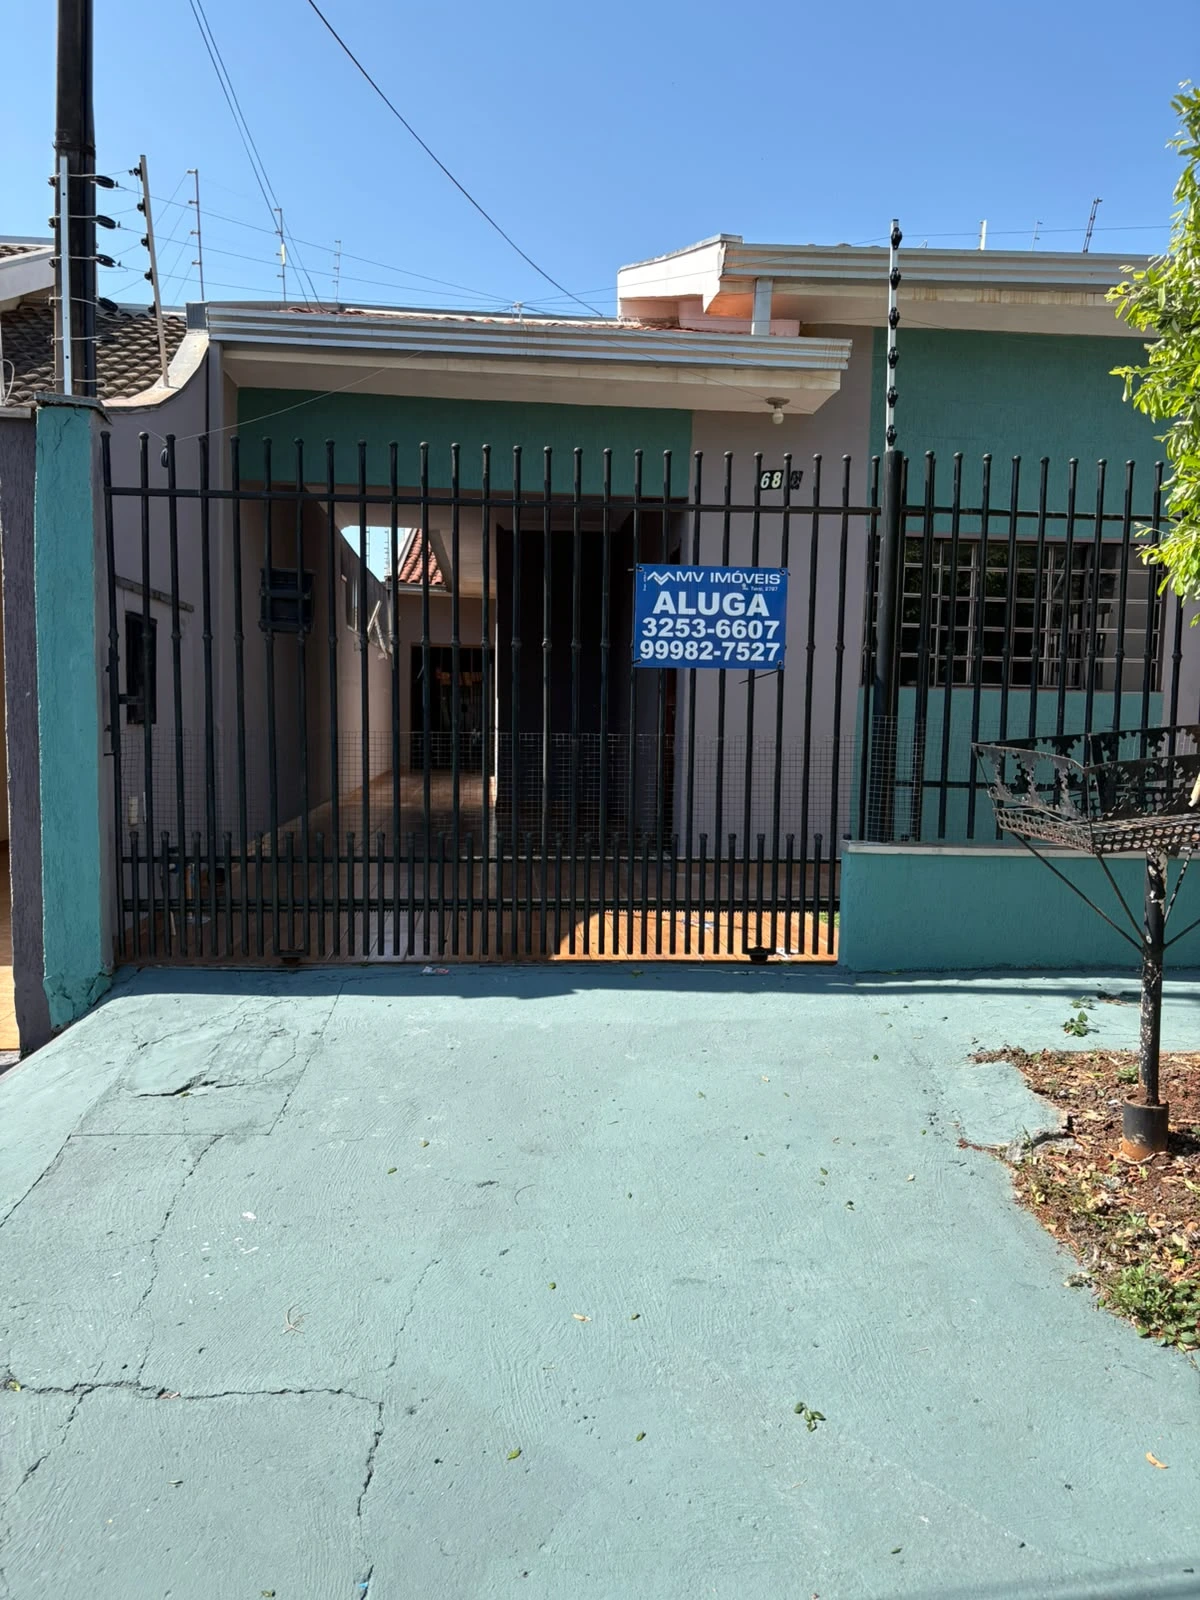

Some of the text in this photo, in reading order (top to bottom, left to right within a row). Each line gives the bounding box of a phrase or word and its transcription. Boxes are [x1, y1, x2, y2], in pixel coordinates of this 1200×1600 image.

[676, 570, 781, 585] MV IMÓVEIS
[652, 591, 770, 617] ALUGA
[641, 617, 780, 640] 3253-6607
[639, 639, 780, 662] 99982-7527
